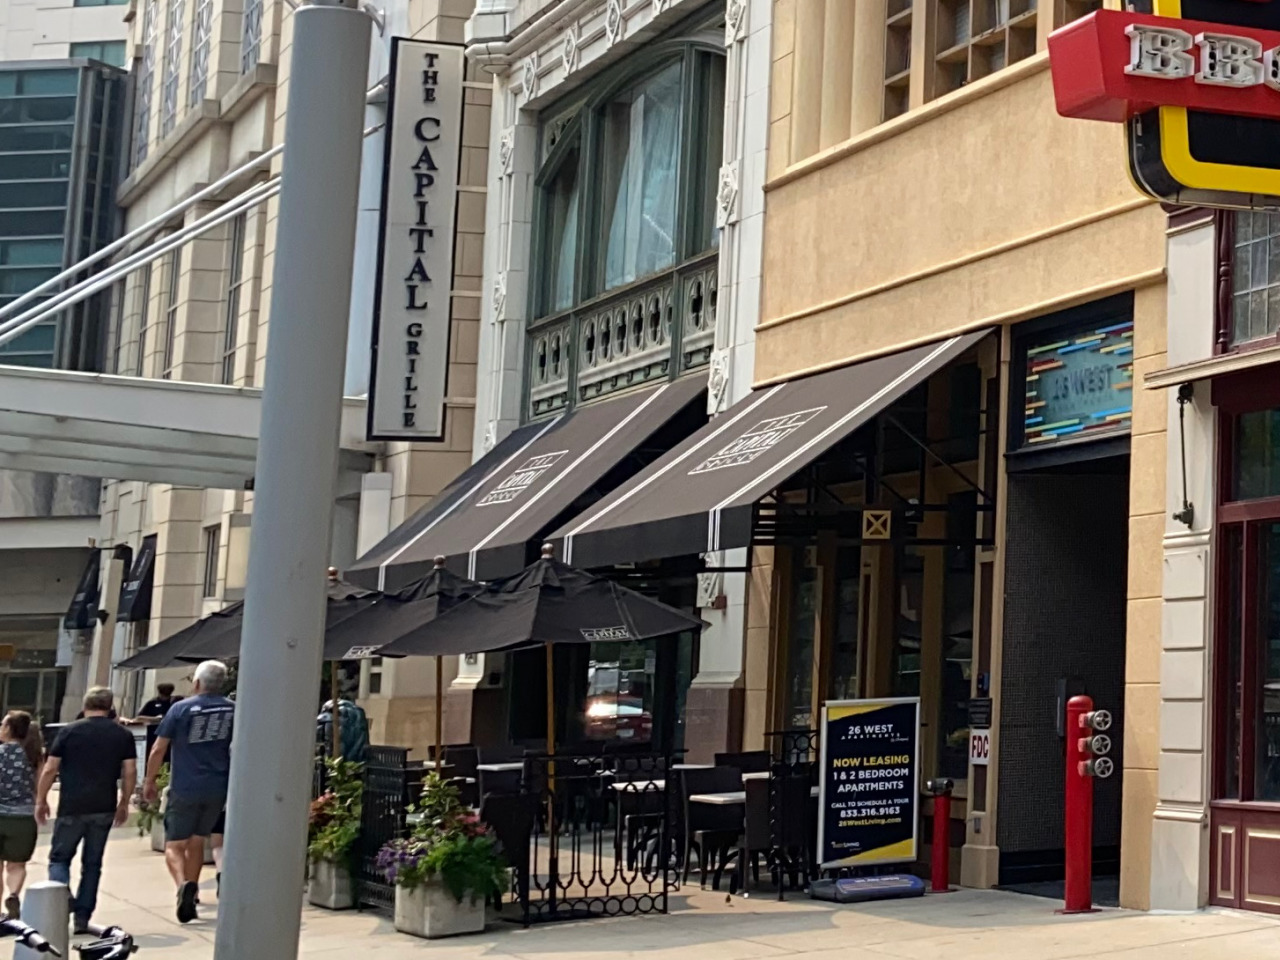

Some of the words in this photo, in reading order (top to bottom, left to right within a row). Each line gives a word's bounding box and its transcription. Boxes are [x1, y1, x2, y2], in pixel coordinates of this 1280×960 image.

[422, 53, 439, 103] THE
[404, 117, 441, 310] CAPITAL
[403, 322, 423, 428] GRILLE
[848, 726, 861, 735] 26
[864, 724, 893, 734] WEST
[972, 735, 988, 758] FDC
[833, 757, 861, 768] NOW
[863, 755, 909, 766] LEASING
[840, 771, 847, 780] &
[850, 771, 856, 780] 2
[858, 768, 909, 780] BEDROOM
[837, 781, 904, 793] APARTMENTS
[857, 799, 887, 807] SCHEDULE
